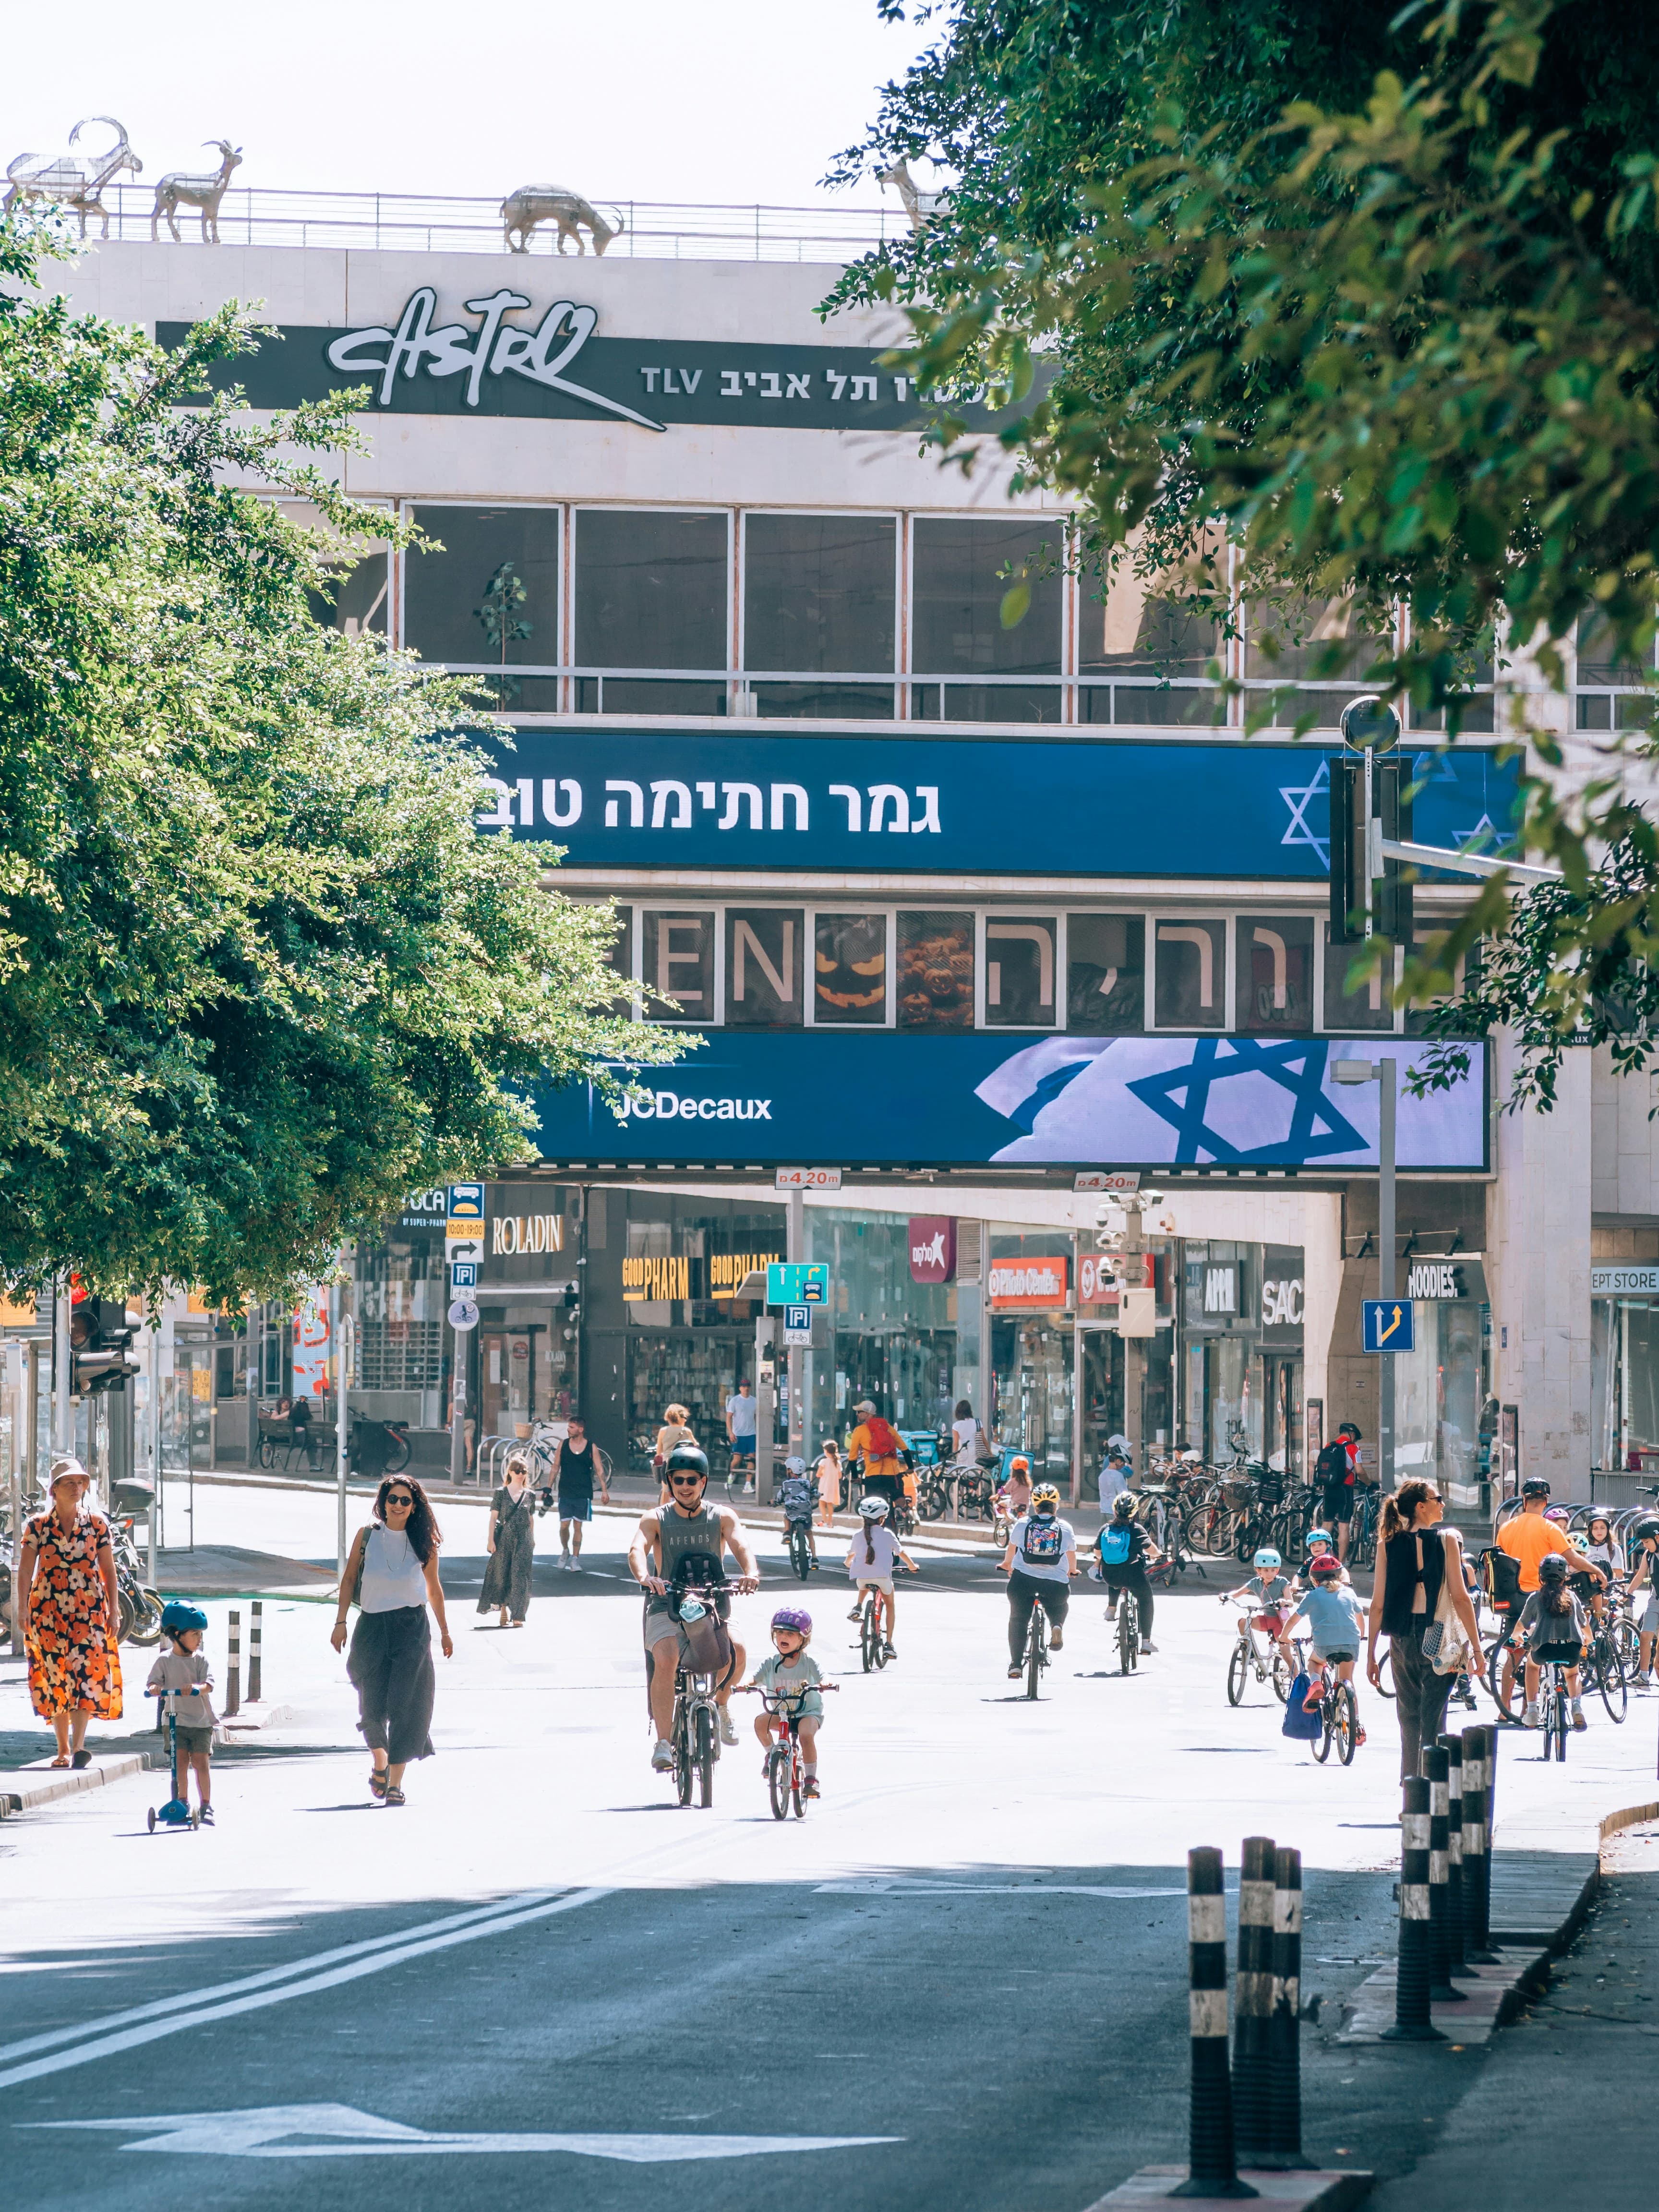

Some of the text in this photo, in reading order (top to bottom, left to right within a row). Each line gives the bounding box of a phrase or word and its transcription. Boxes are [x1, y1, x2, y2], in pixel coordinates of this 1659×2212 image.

[641, 367, 703, 394] TLV
[720, 371, 811, 399] אביב
[826, 369, 878, 401] תל
[478, 778, 941, 833] גמר חתימה טוב
[622, 1092, 772, 1119] JCDecaux
[790, 1172, 827, 1184] 4.20
[1088, 1177, 1126, 1188] 4.20
[492, 1214, 562, 1255] ROLADIN
[913, 1242, 933, 1267] סלקום
[622, 1257, 689, 1300] GOOD PHARM
[710, 1255, 733, 1285] GOOD
[999, 1267, 1055, 1296] Photo Center
[1592, 1273, 1657, 1288] EPT STORE
[1262, 1279, 1305, 1325] SAC
[670, 1534, 710, 1546] AFENDS
